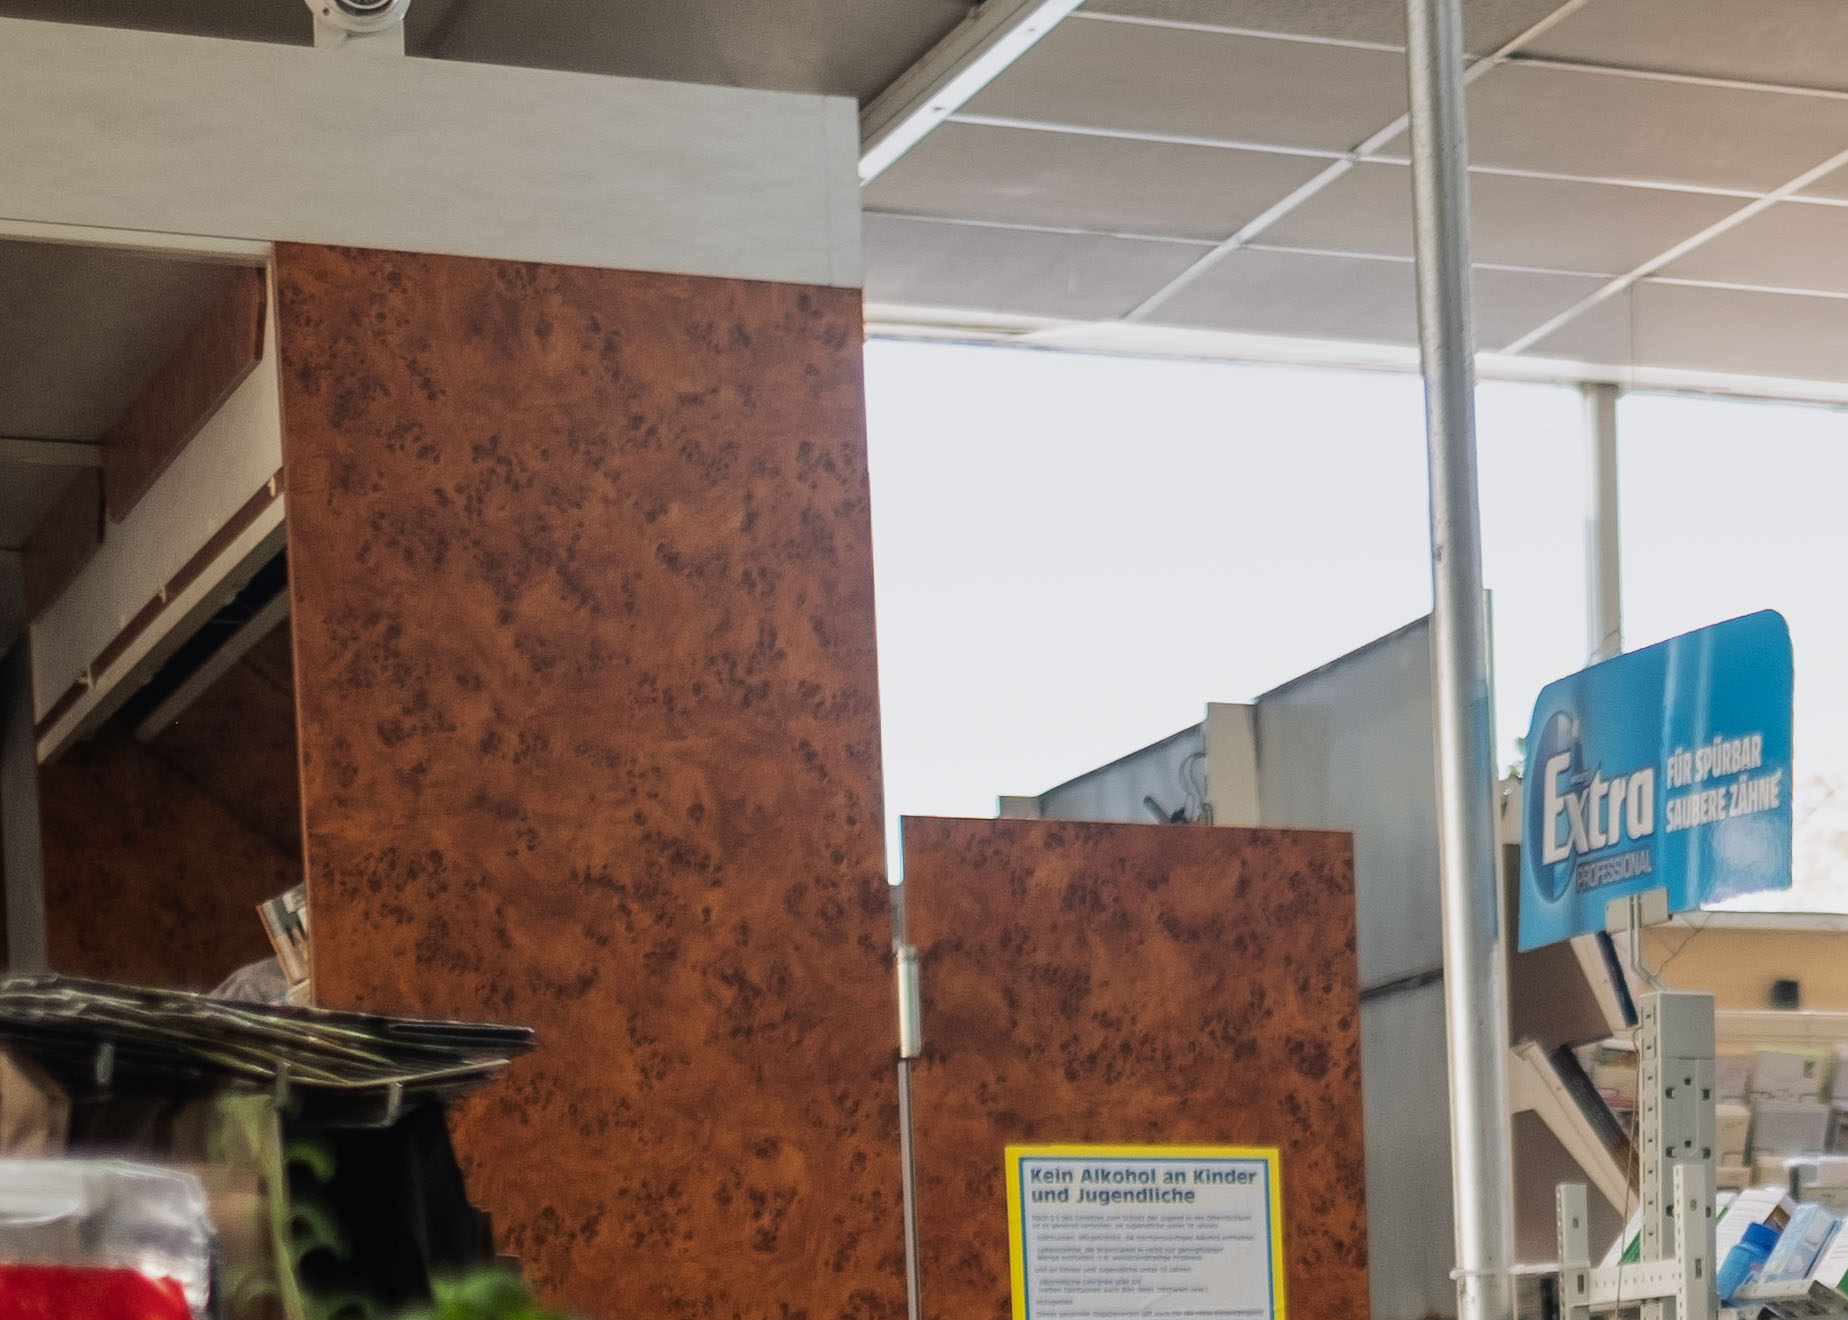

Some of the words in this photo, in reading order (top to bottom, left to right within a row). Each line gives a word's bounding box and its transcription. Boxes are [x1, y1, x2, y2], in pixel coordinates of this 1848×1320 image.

[1666, 742, 1693, 790] FÜR
[1694, 731, 1763, 780] SPÜRBAR
[1541, 752, 1655, 866] Extra
[1666, 787, 1727, 834] SAUBERE
[1729, 768, 1781, 824] ZÄHNE
[1576, 849, 1654, 894] PROFESSIONAL
[1030, 1168, 1073, 1185] Kein
[1081, 1168, 1156, 1185] Alkohol
[1163, 1171, 1186, 1185] an
[1193, 1168, 1257, 1186] Kinder
[1031, 1187, 1069, 1204] und
[1076, 1187, 1196, 1206] Jugendliche
